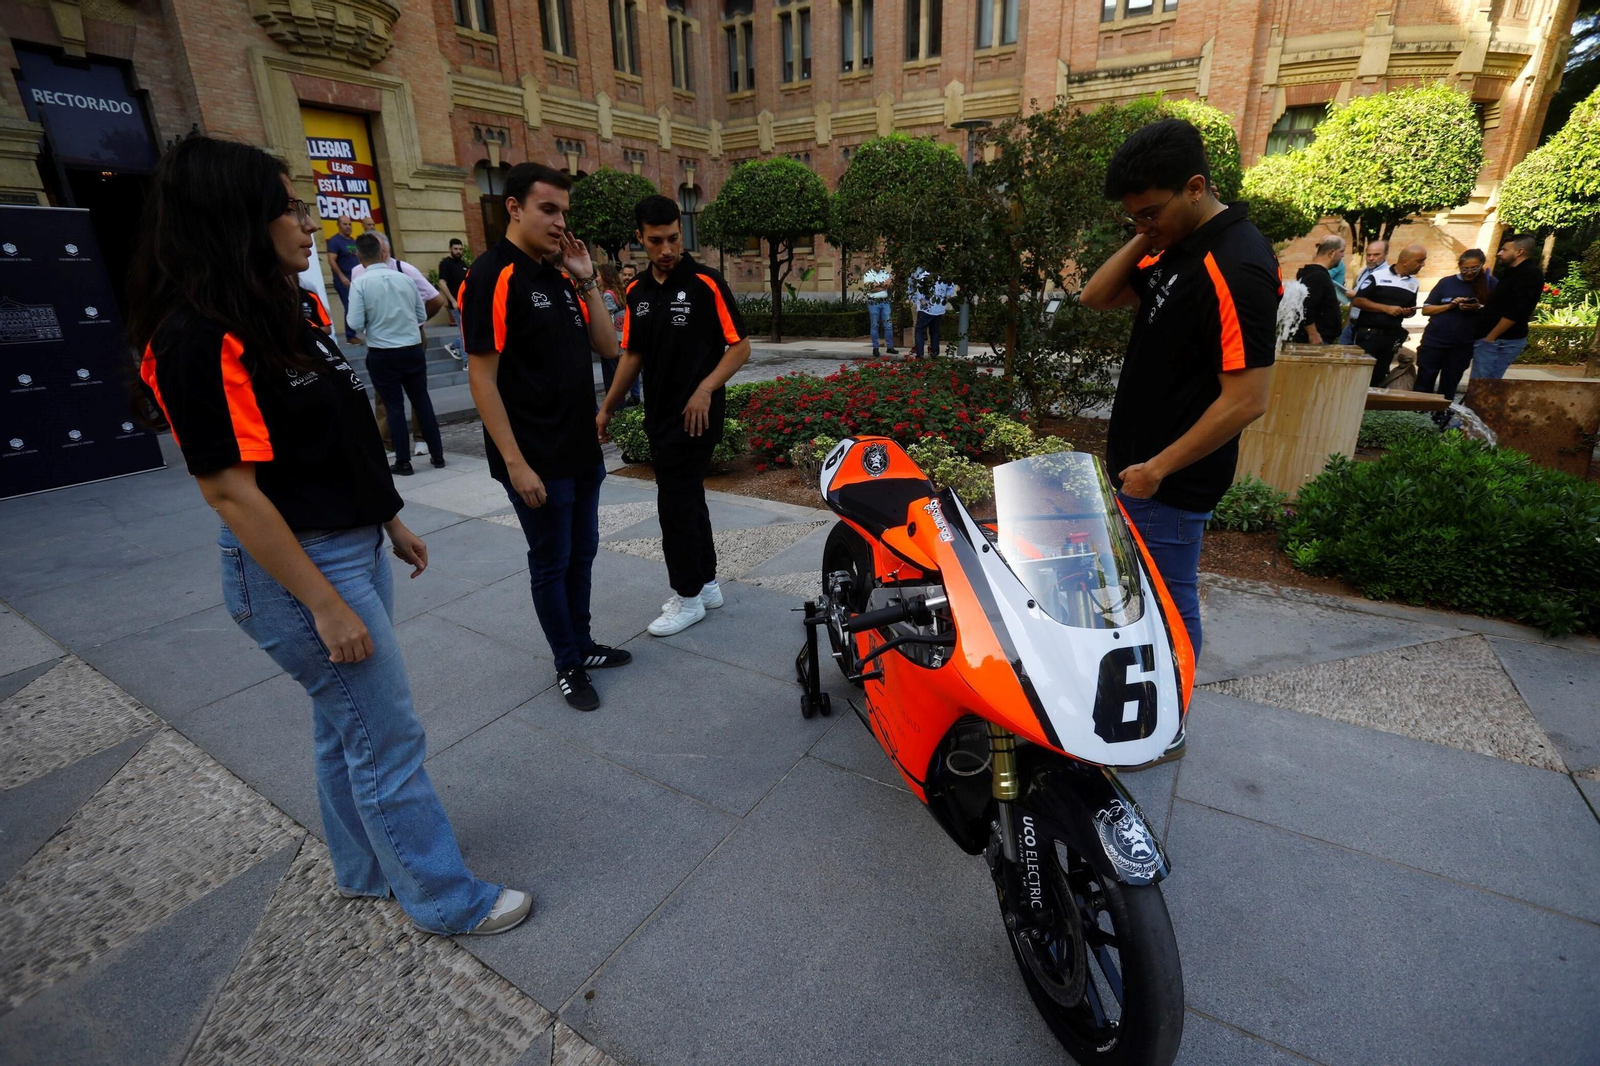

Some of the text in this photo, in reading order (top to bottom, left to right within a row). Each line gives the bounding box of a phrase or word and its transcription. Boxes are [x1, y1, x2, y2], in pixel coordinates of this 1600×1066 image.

[31, 88, 133, 115] RECTORADO
[306, 140, 352, 158] LLEGAR
[331, 161, 354, 175] LEJOS
[317, 175, 368, 193] ESTÁ MUY
[316, 195, 372, 220] CERCA
[1092, 643, 1158, 744] 6
[1022, 816, 1043, 909] UCO ELECTRIC
